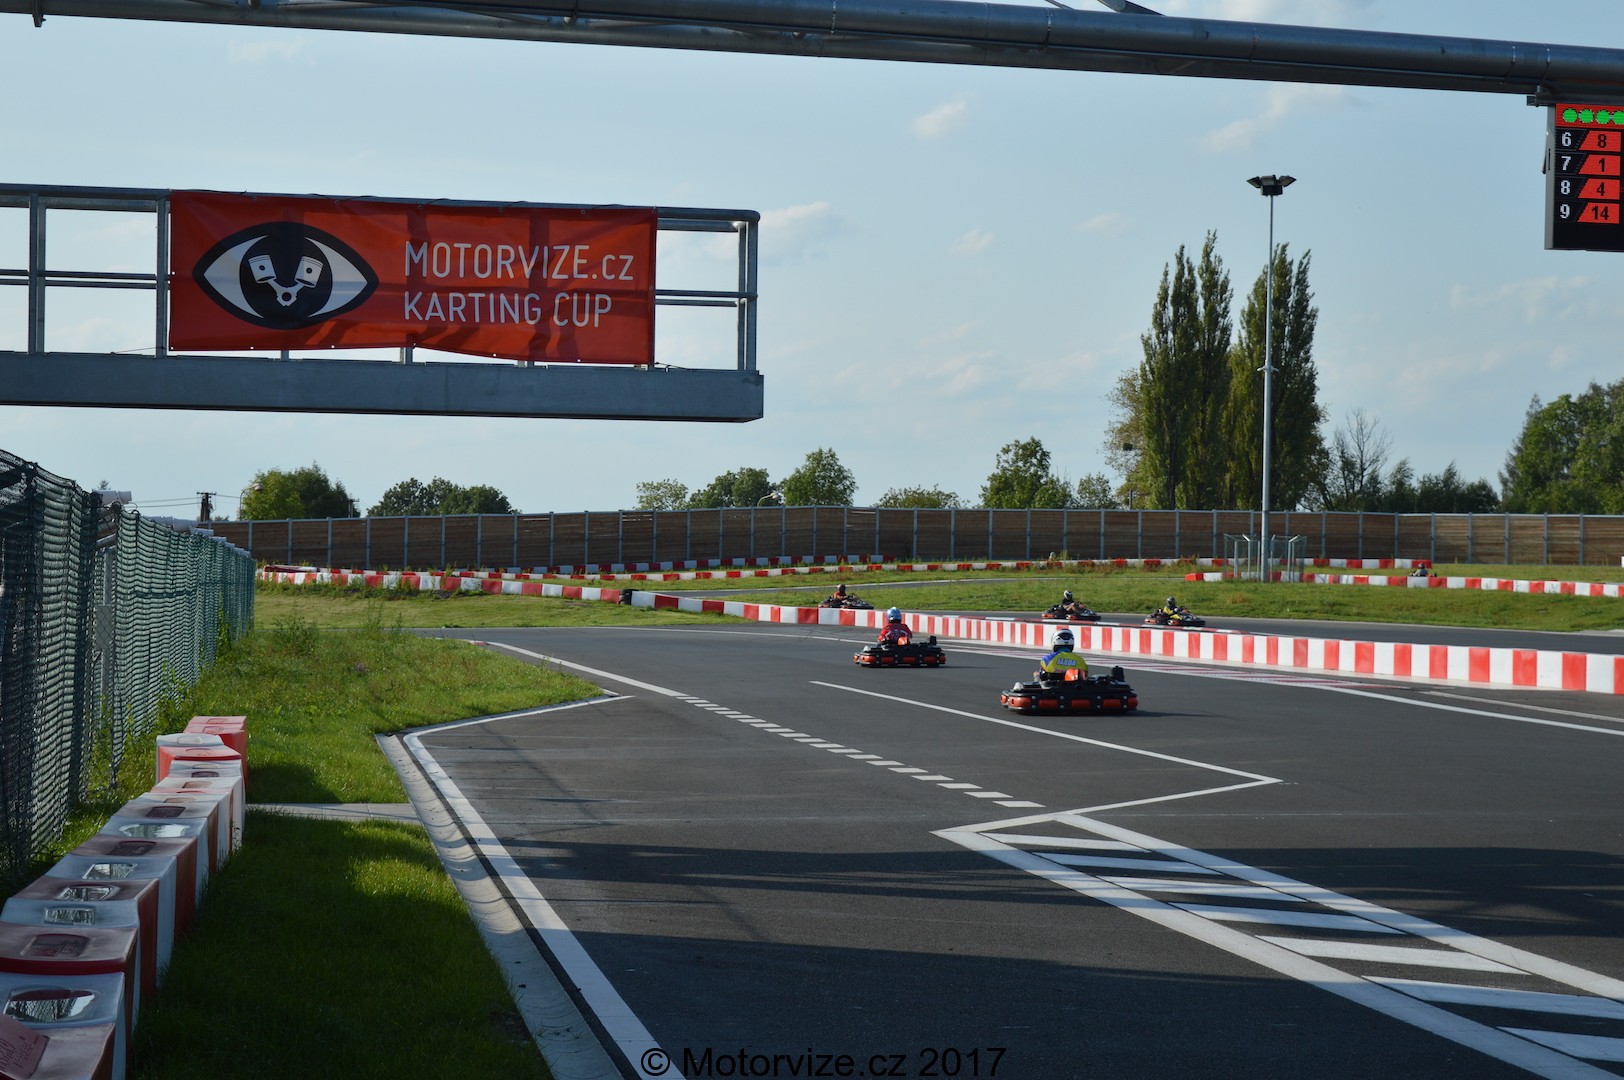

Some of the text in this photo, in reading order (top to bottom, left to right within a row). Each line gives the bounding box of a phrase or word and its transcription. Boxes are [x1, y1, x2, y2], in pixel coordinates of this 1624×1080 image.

[1561, 131, 1607, 148] 6 8
[1561, 156, 1605, 172] 7 1
[1560, 180, 1606, 196] 8 4
[1560, 204, 1609, 220] 9 14
[404, 291, 612, 328] KARTING CUP
